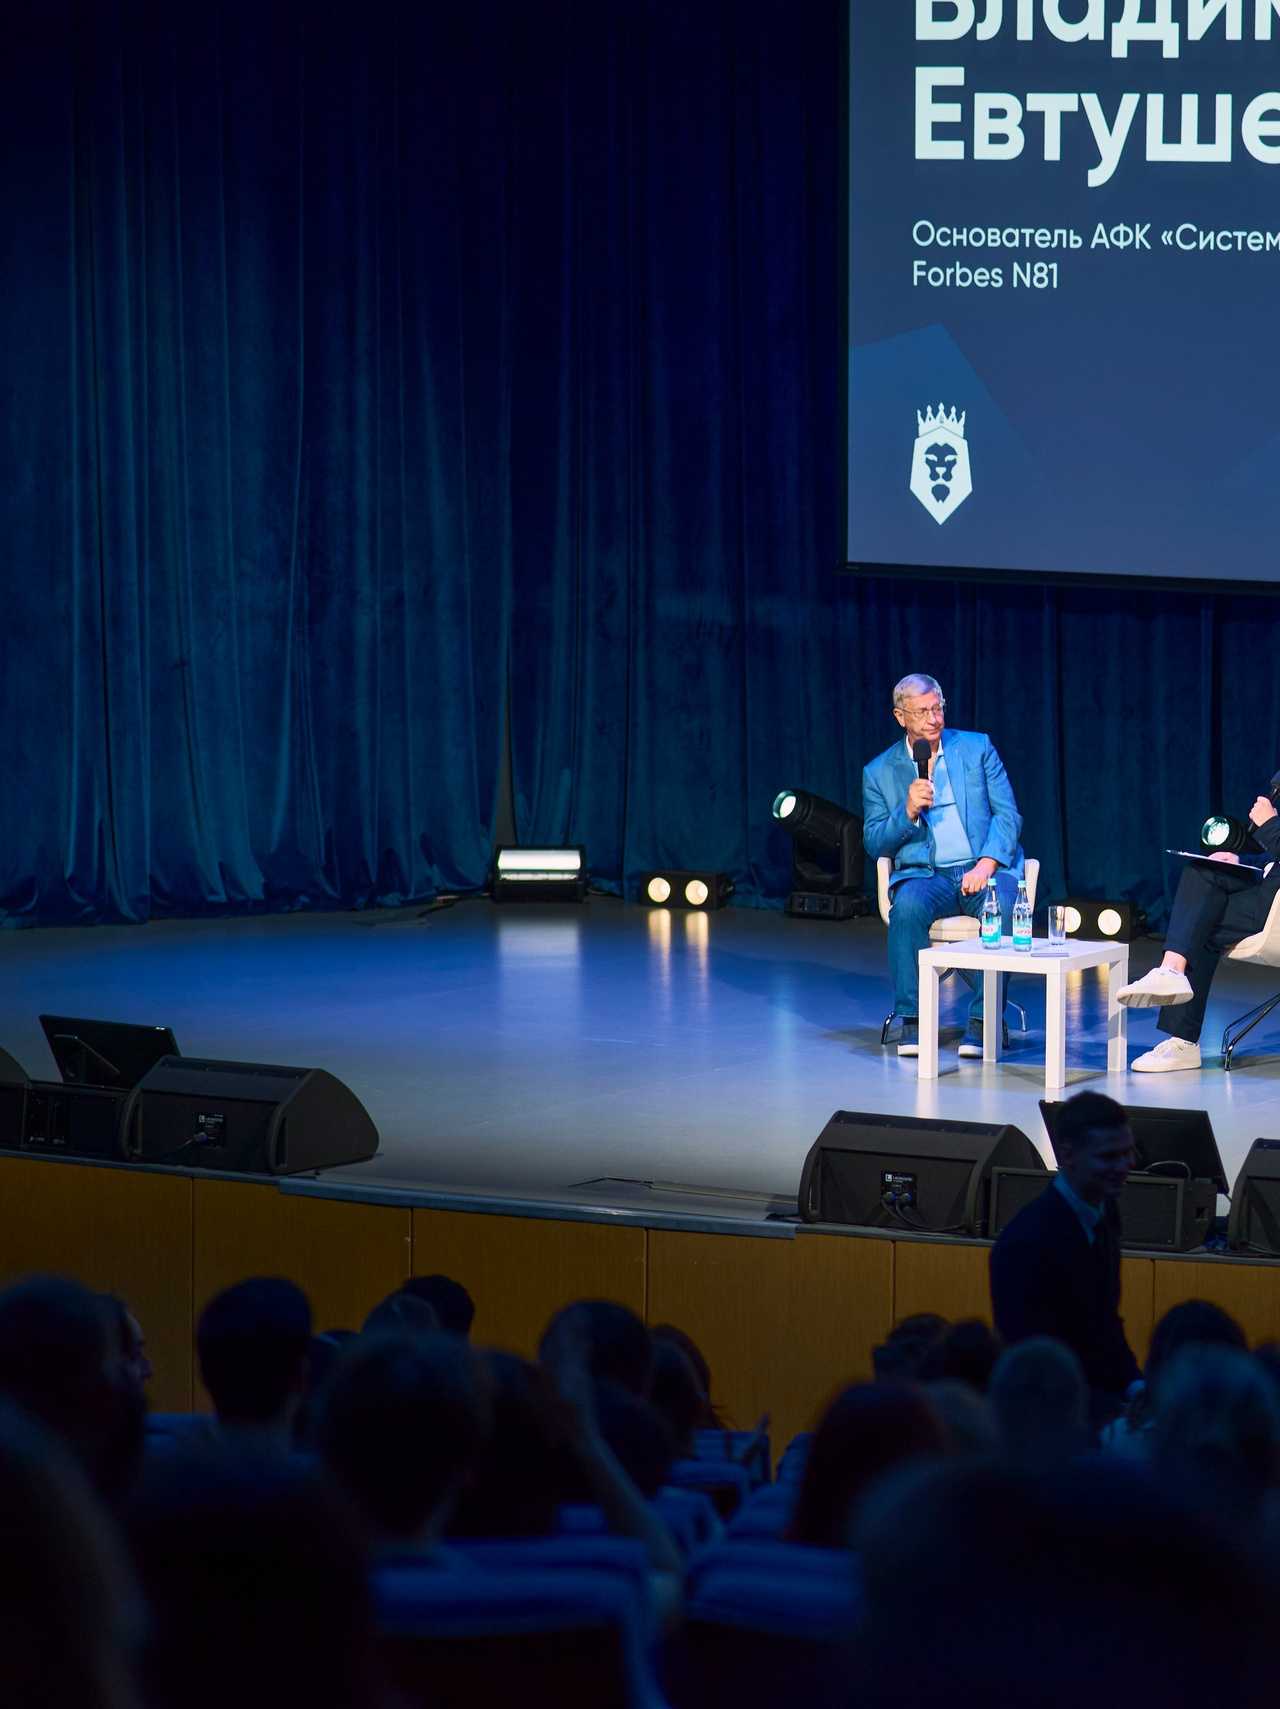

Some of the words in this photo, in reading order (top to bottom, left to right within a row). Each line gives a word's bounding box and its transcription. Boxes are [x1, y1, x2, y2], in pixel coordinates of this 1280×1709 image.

[913, 220, 1082, 248] Основатель
[1091, 223, 1151, 249] АФК
[914, 261, 1003, 287] Forbes
[1013, 262, 1057, 288] N81
